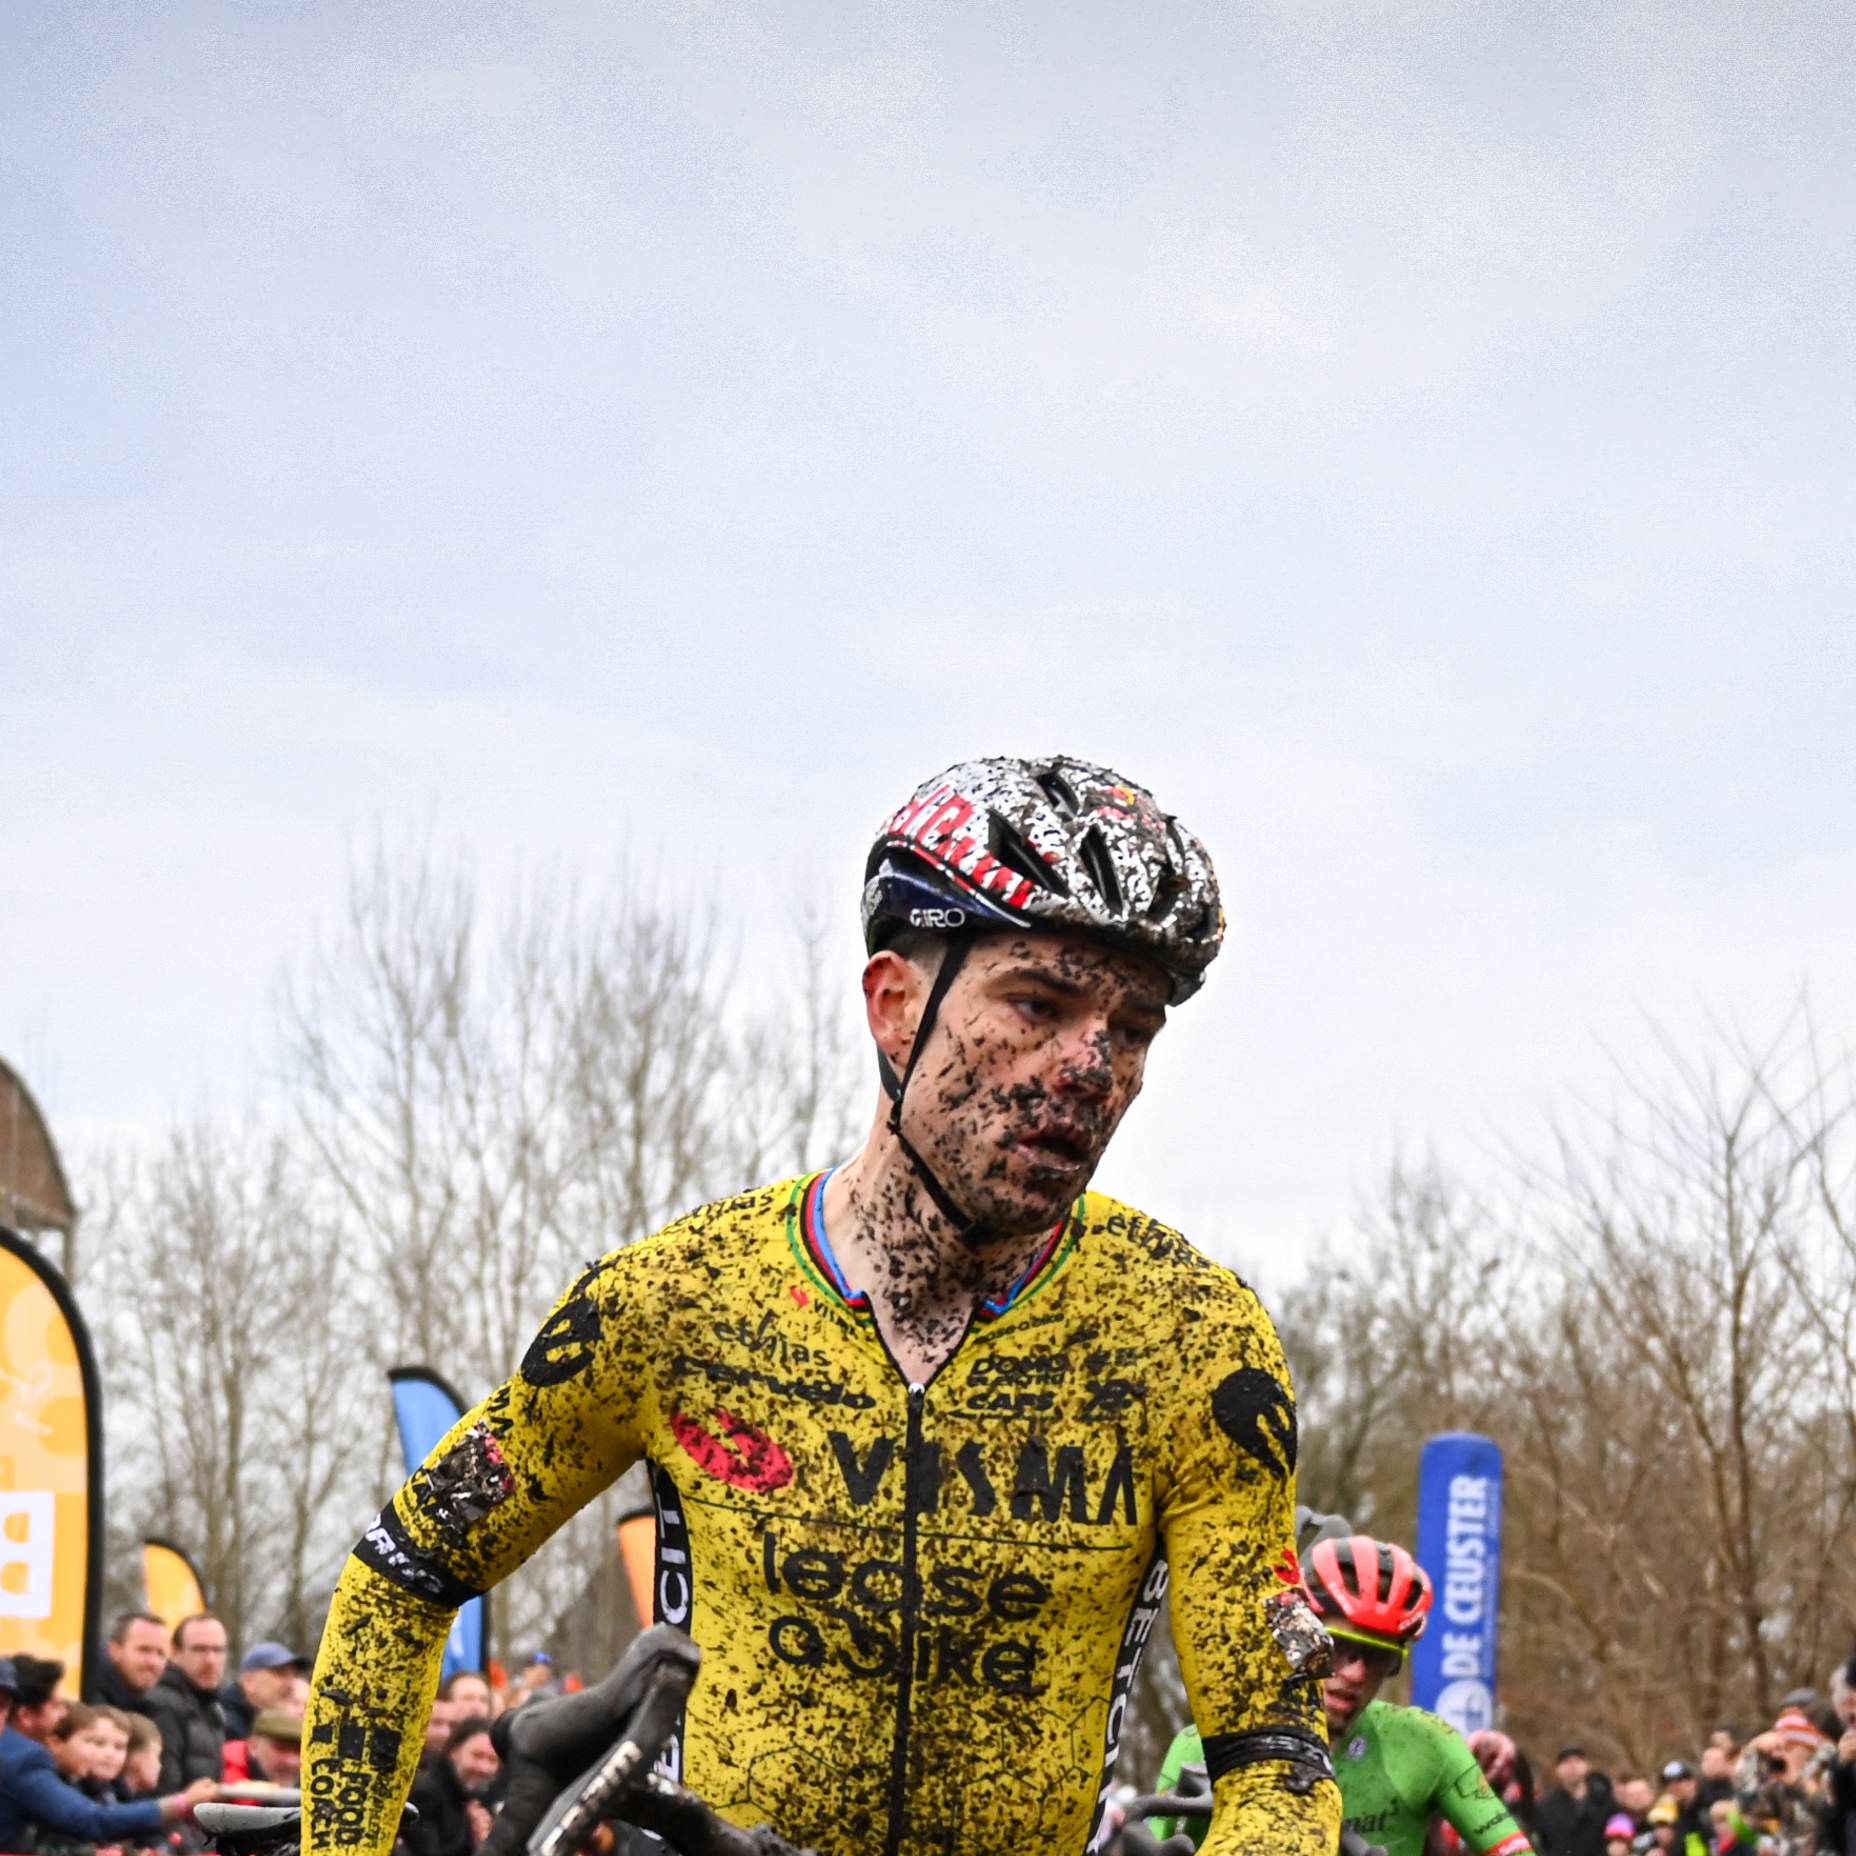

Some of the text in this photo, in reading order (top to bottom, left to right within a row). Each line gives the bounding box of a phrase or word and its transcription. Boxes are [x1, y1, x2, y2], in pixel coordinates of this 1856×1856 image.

[909, 908, 965, 929] GIRO
[827, 1430, 1139, 1526] VISMA
[1441, 1474, 1489, 1679] DE CEUSTER
